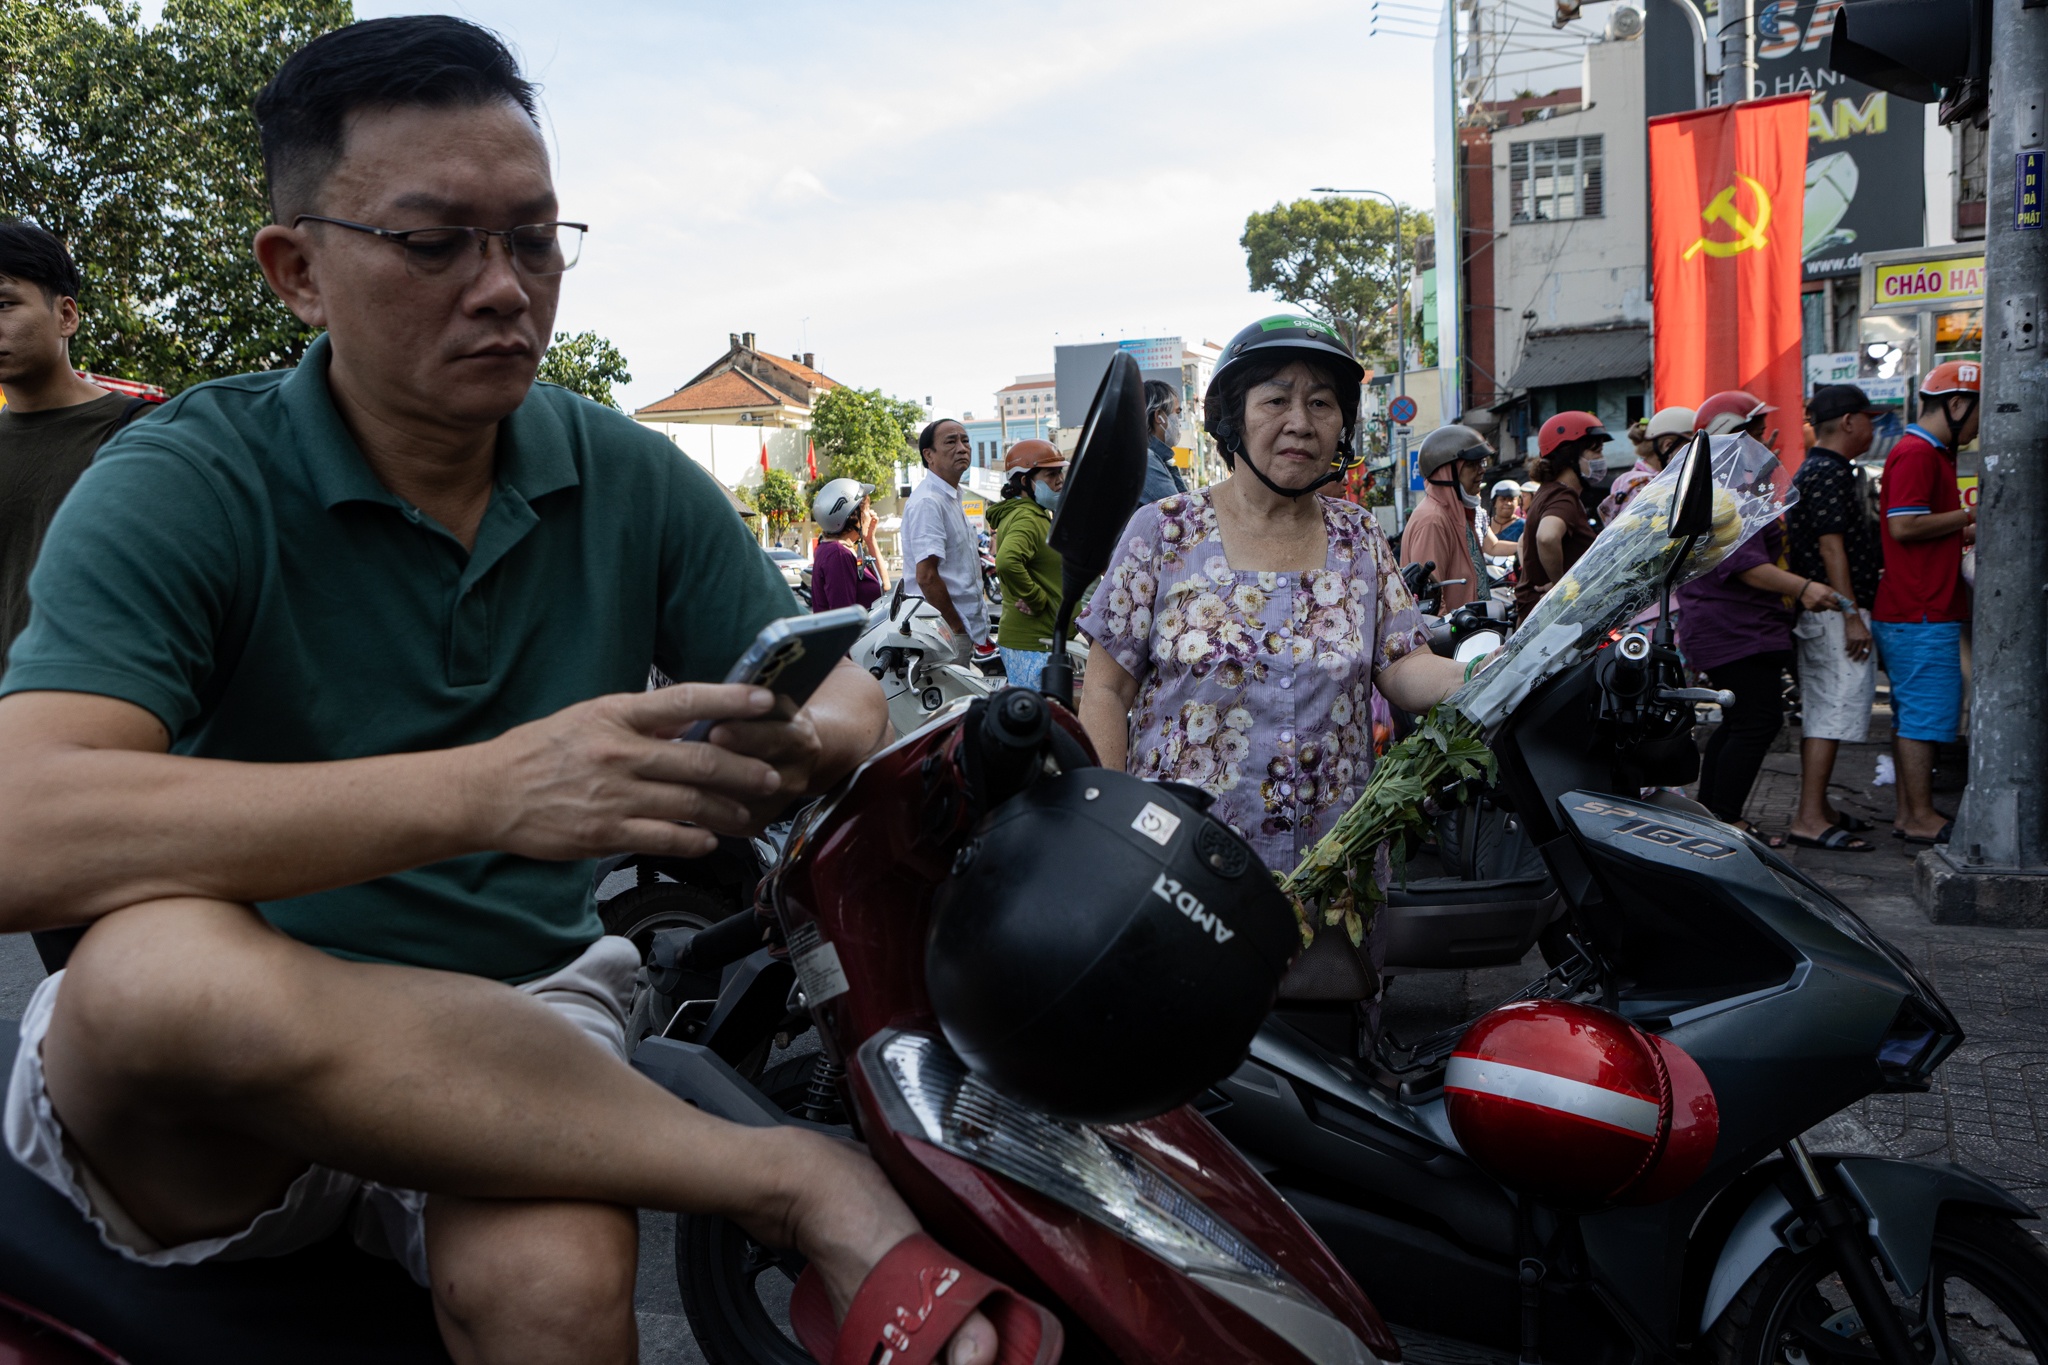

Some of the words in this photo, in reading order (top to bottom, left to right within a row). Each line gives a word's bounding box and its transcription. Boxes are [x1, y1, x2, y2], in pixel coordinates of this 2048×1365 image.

[1775, 67, 1846, 97] HÀN
[2027, 155, 2035, 167] A
[2026, 173, 2036, 187] DI
[2023, 191, 2037, 206] ĐÀ
[2017, 209, 2041, 226] PHẬT
[1884, 267, 1942, 296] CHÁO
[1573, 800, 1638, 818] SP
[1612, 819, 1738, 861] 160
[1172, 888, 1235, 944] AMD
